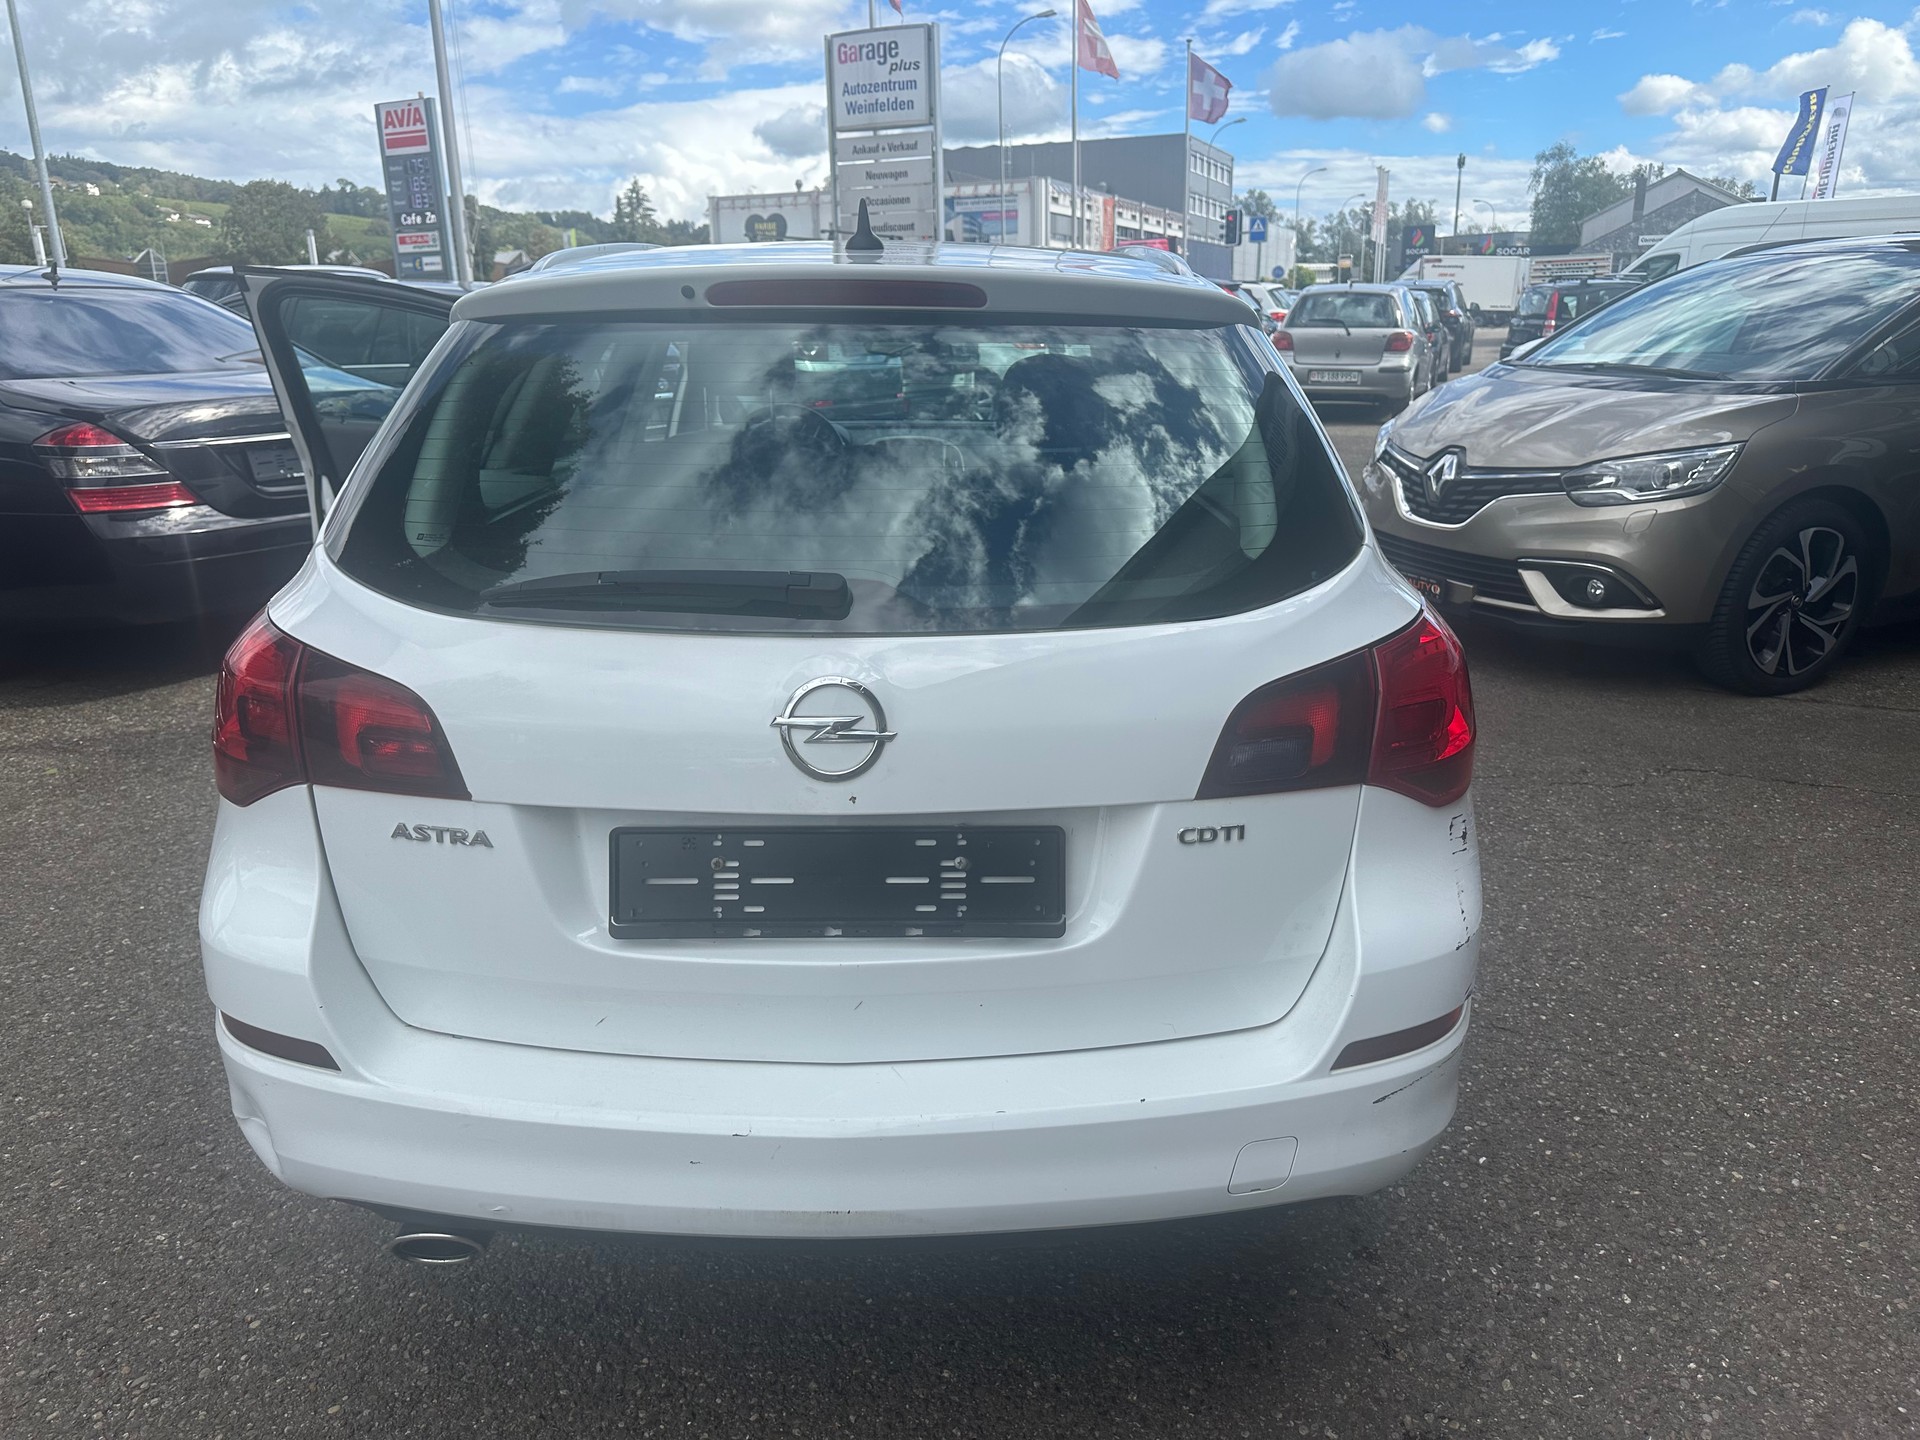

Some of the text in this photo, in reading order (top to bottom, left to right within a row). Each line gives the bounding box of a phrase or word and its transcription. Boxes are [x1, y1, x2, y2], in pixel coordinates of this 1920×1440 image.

[837, 40, 899, 66] Garage
[889, 59, 920, 75] plus
[842, 79, 917, 97] Autozentrum
[845, 97, 914, 115] Weinfelden
[852, 143, 879, 155] Ankauf
[887, 140, 918, 152] Verkauf
[865, 170, 909, 181] Neuwagen
[401, 213, 422, 225] Cafe
[1496, 247, 1531, 256] SOCAR
[390, 822, 494, 848] ASTRA
[1177, 824, 1245, 845] CDTI
